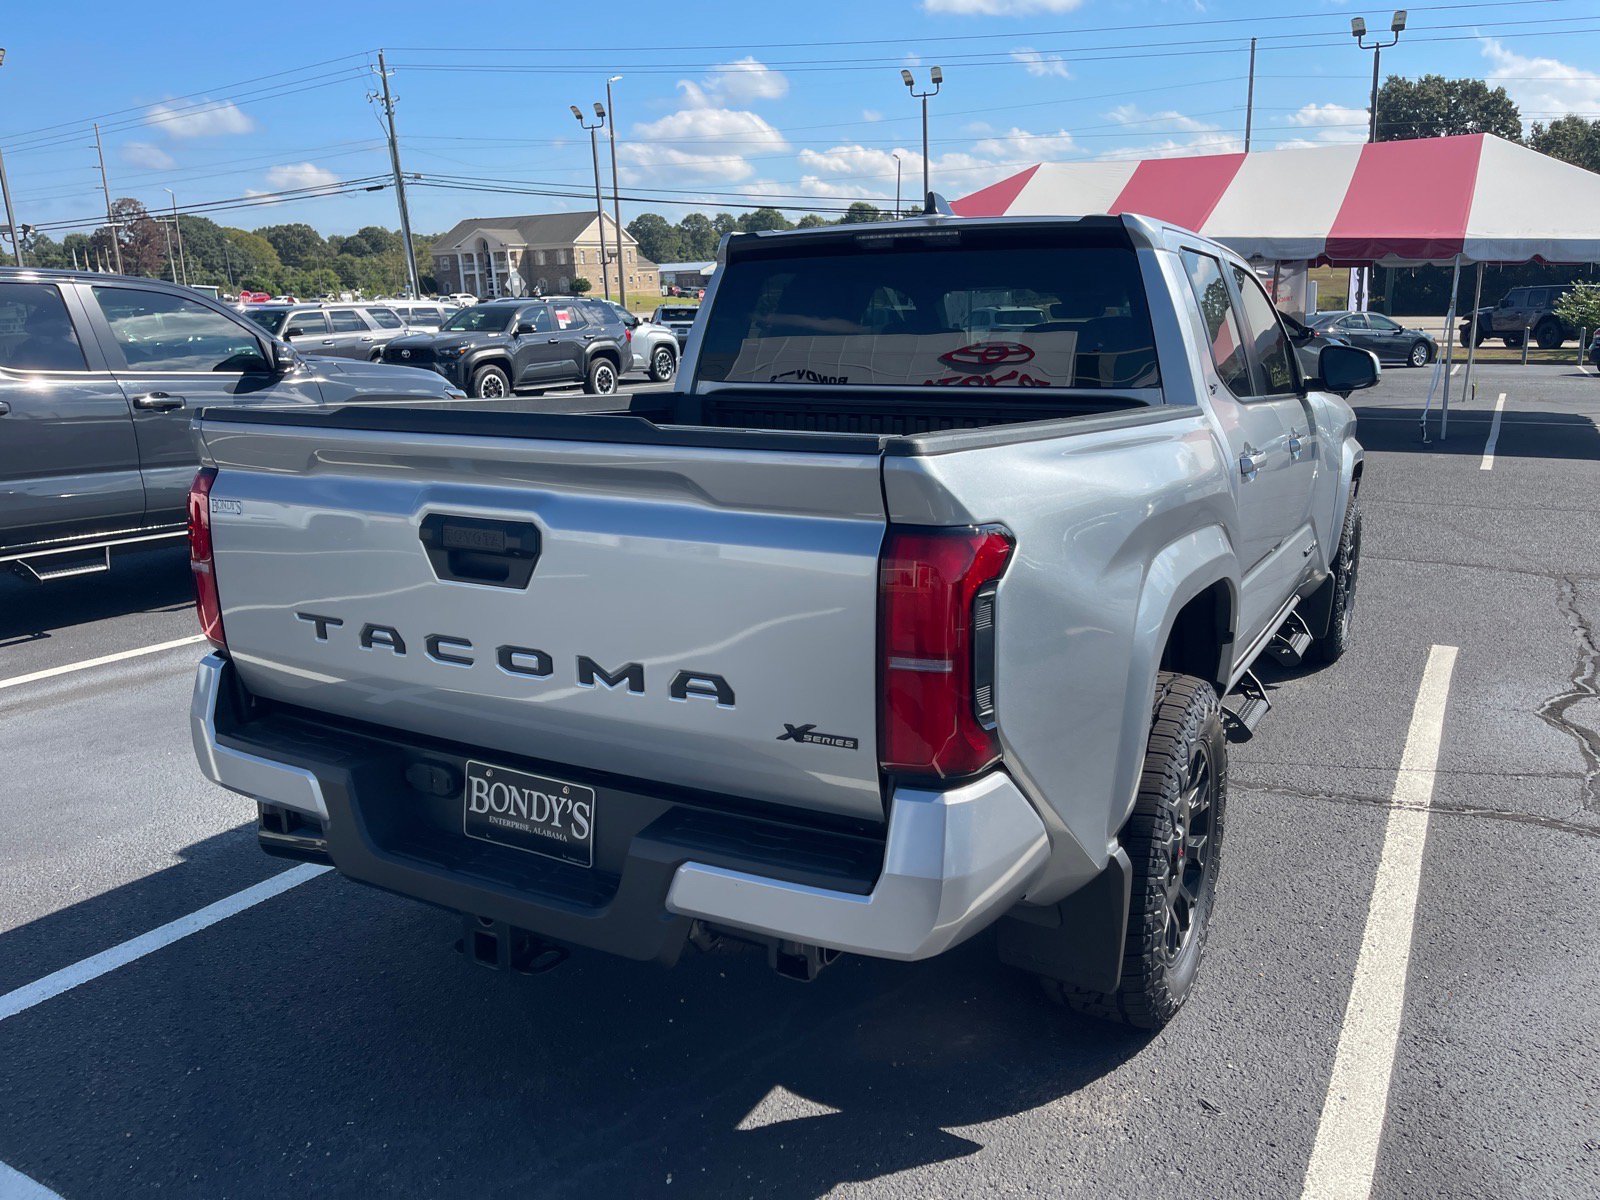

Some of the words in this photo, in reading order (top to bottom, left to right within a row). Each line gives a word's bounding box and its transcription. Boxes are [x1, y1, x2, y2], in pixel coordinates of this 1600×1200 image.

[444, 528, 502, 549] TOYOTA
[294, 612, 736, 710] TACOMA
[803, 733, 856, 749] SERIES
[469, 776, 590, 840] BONDY'S
[488, 815, 532, 833] ENTERPRISE,
[533, 827, 568, 842] ALABAMA
